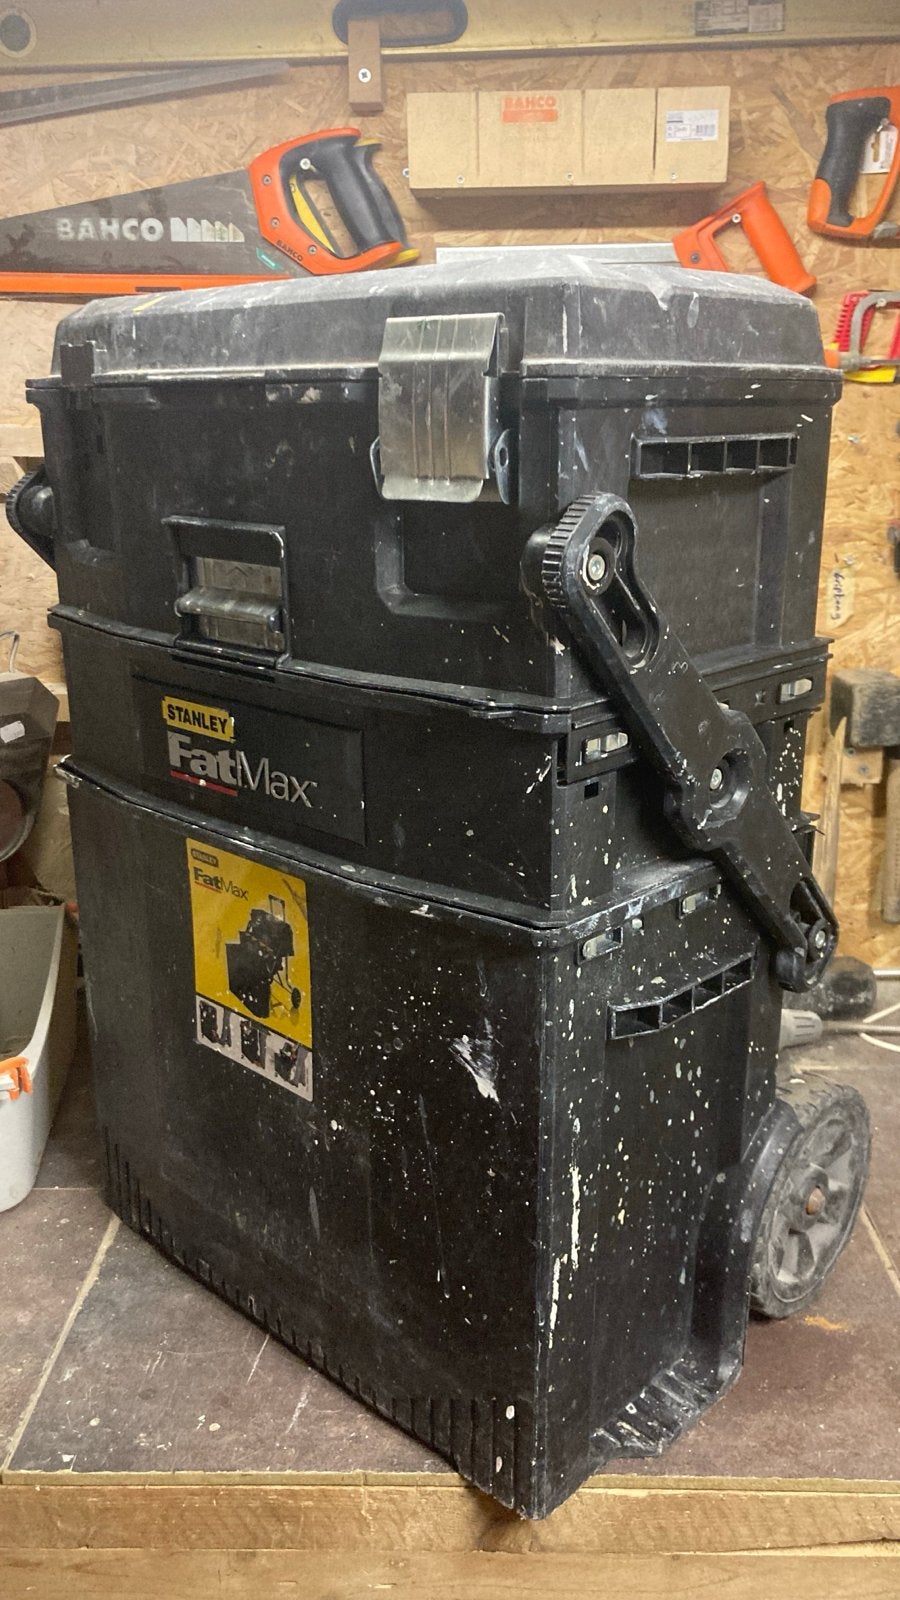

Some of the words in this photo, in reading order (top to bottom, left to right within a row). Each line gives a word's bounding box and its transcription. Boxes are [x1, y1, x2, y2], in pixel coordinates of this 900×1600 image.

[503, 95, 557, 110] BAHCO
[56, 217, 164, 242] BAHCO
[276, 239, 303, 262] BAHCO
[167, 703, 229, 734] STANLEY
[167, 730, 314, 808] FatMax
[193, 866, 249, 901] FatMax
